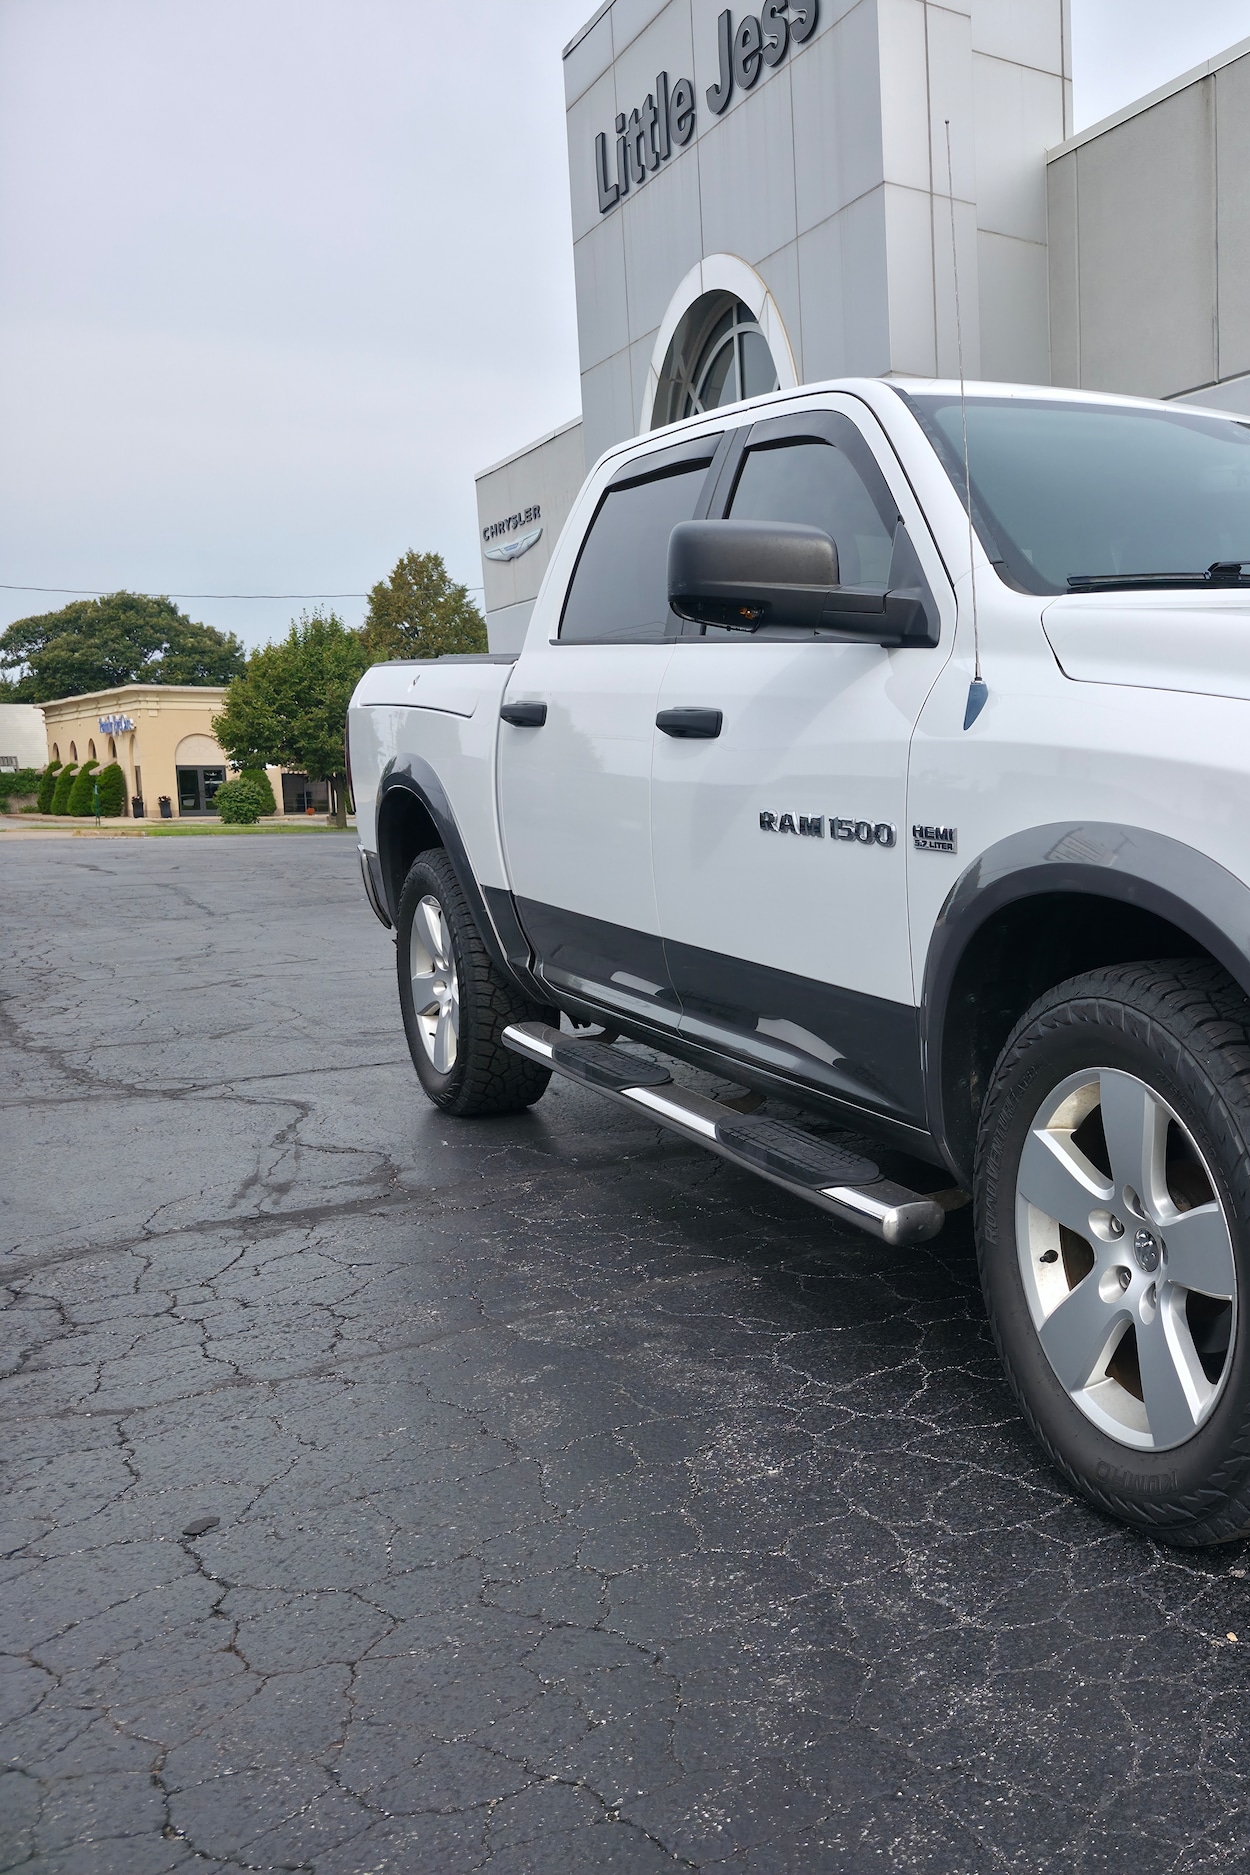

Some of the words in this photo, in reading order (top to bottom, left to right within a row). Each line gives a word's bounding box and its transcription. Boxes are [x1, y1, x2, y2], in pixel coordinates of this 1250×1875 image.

[595, 70, 696, 214] Little
[706, 0, 820, 116] Jess
[482, 504, 541, 542] CHRYSLER
[759, 808, 825, 839] RAM
[829, 816, 897, 848] 1500
[912, 824, 957, 842] HEMI
[914, 838, 927, 850] 5.7
[928, 840, 953, 851] LITER
